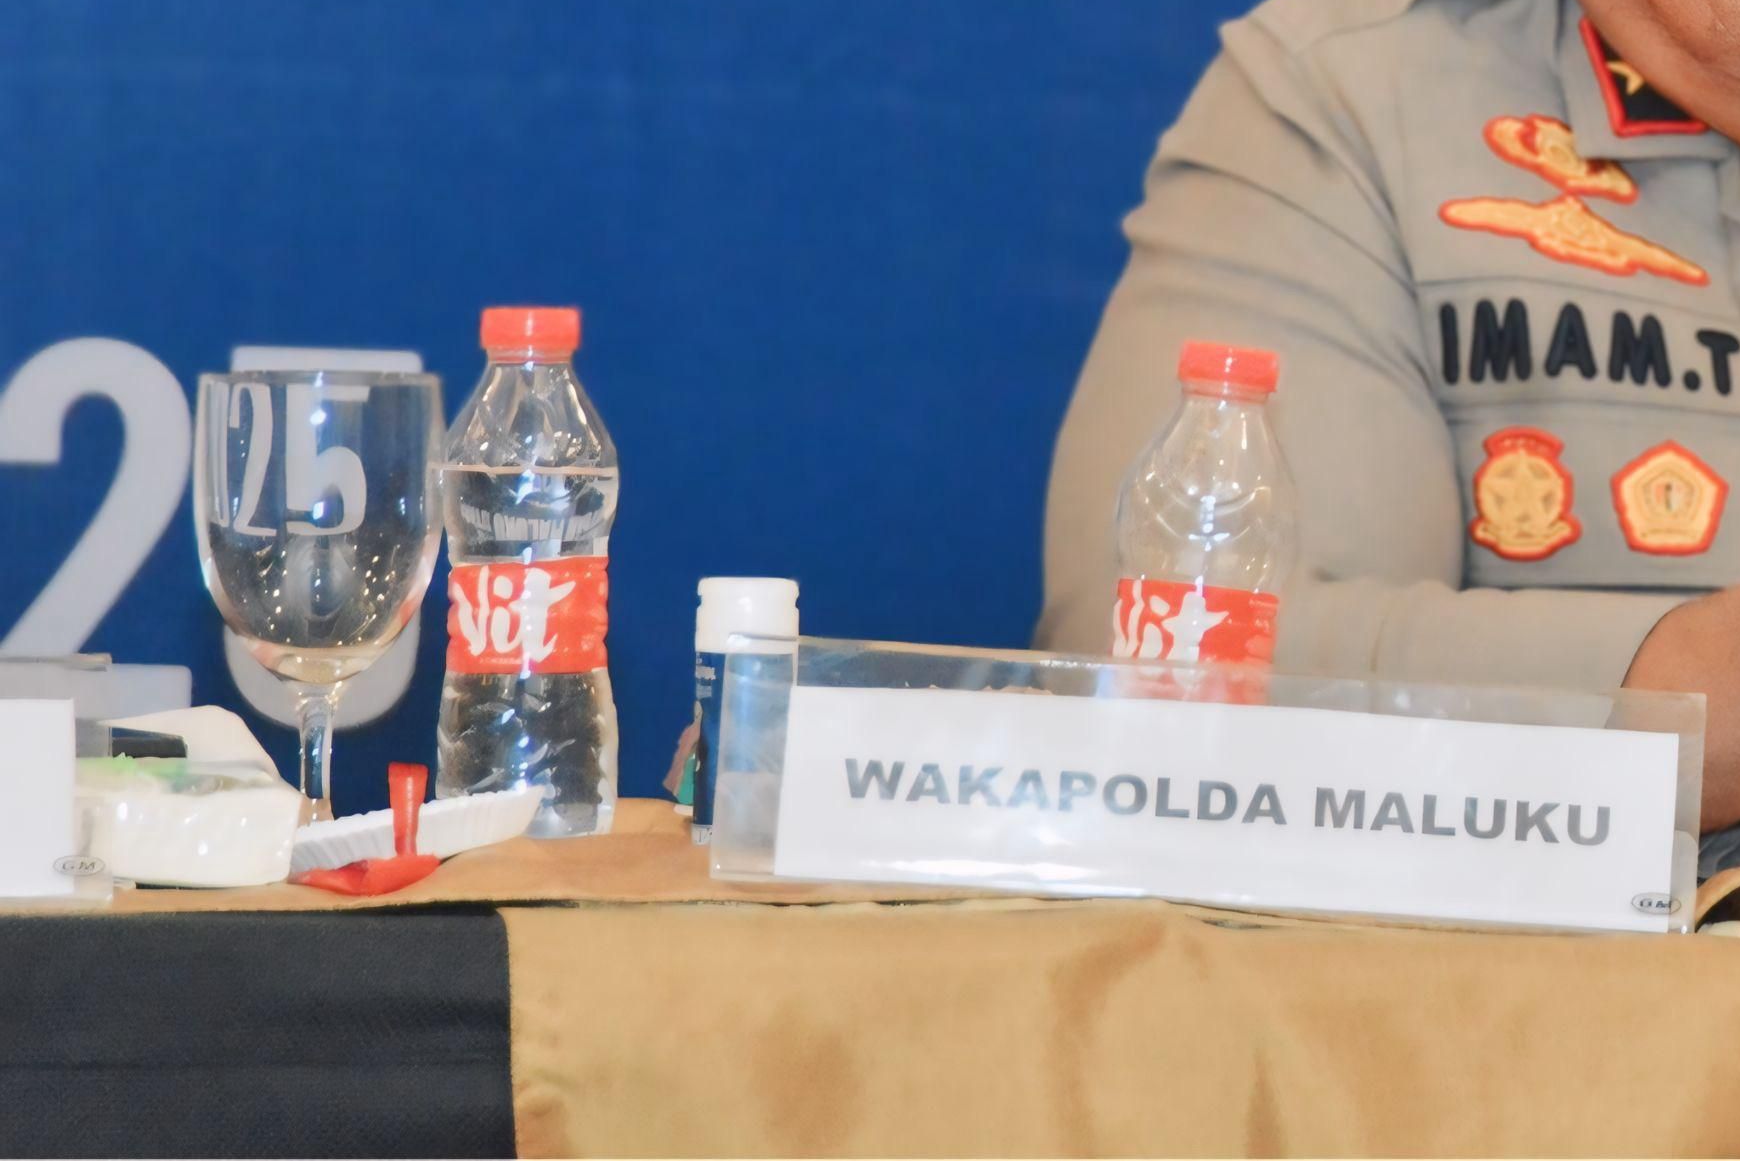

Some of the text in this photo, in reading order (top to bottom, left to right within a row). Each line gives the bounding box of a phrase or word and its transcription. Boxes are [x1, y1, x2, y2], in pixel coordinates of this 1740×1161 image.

[453, 565, 577, 664] Vit
[844, 758, 1612, 847] WAKAPOLDA MALUKU
